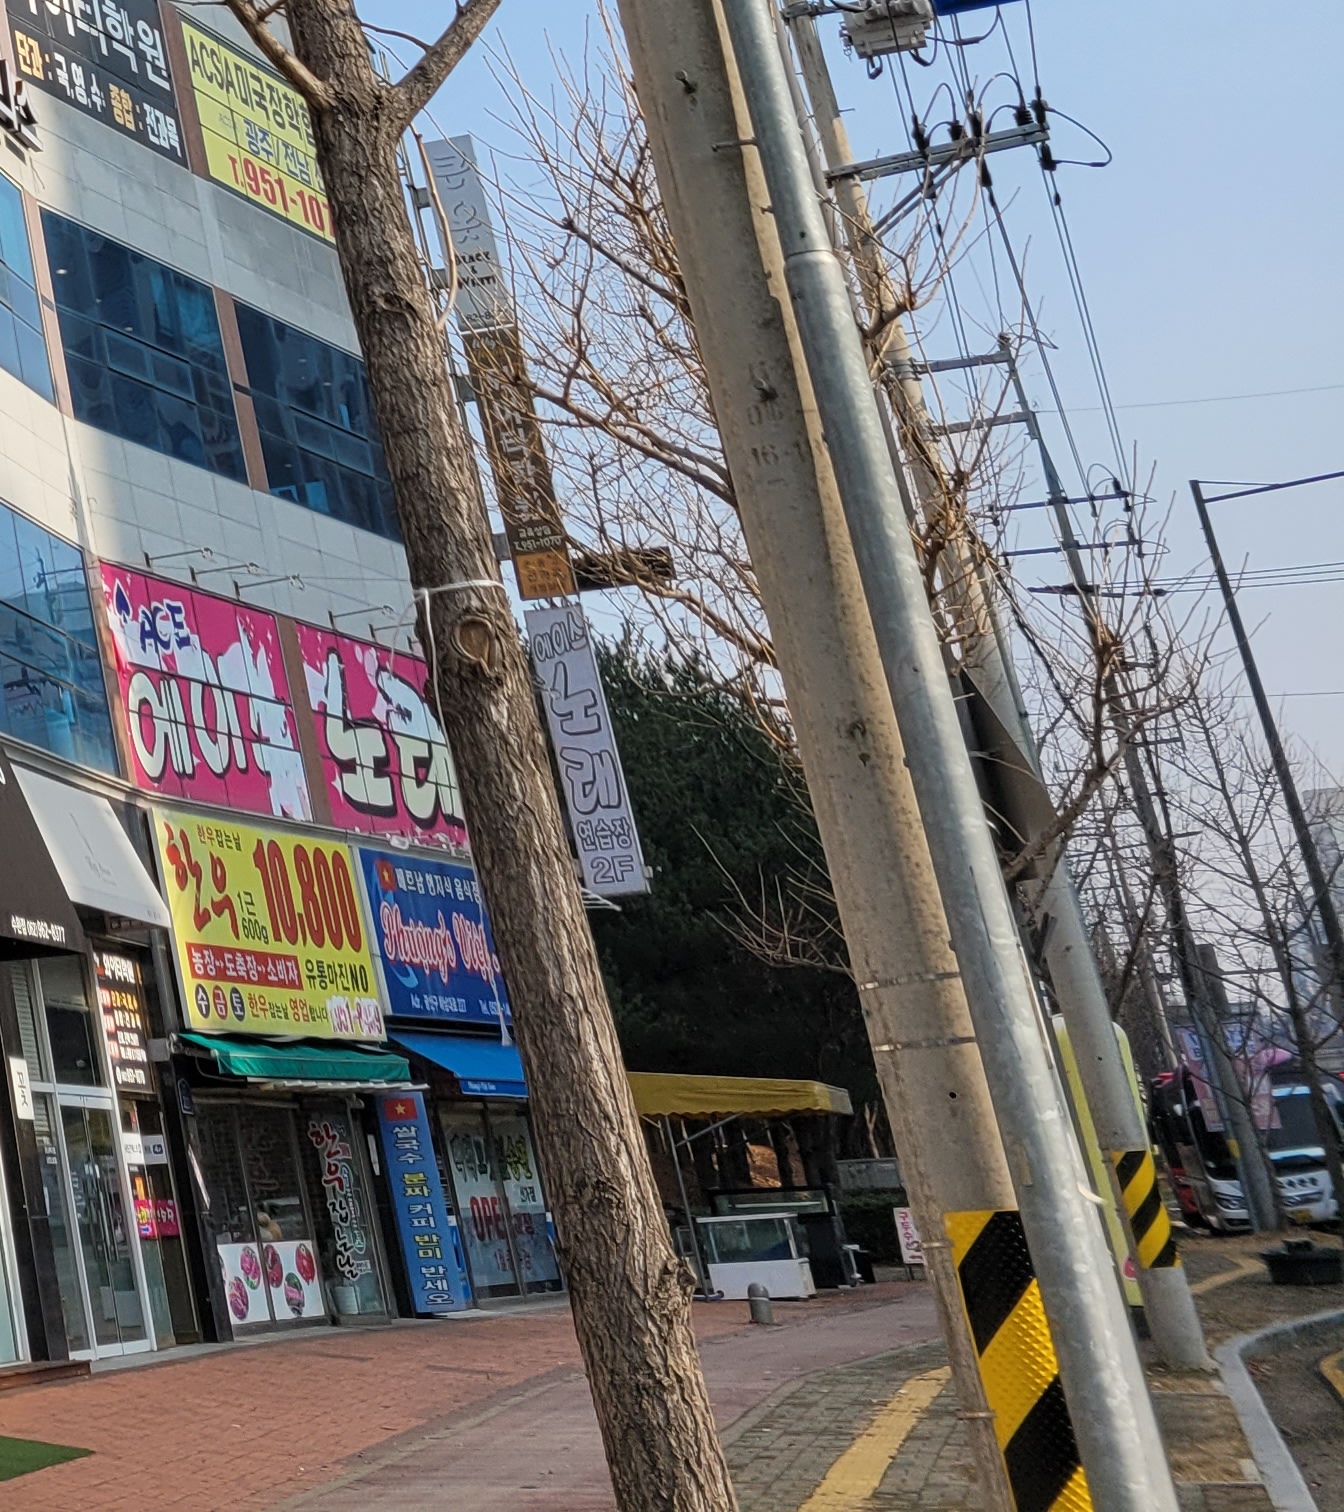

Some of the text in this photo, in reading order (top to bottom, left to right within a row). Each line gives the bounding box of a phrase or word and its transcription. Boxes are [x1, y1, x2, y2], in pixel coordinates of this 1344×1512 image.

[139, 600, 192, 653] ACE
[534, 612, 588, 663] 에이스
[550, 660, 623, 815] 노래
[577, 816, 633, 852] 연습장
[591, 855, 635, 885] 2F
[237, 890, 256, 917] 1근
[253, 838, 362, 953] 10,800
[241, 916, 270, 945] 600g
[223, 951, 259, 982] 도축장
[266, 955, 299, 986] 소비자
[196, 986, 210, 1014] 수
[213, 988, 227, 1017] 금
[230, 990, 244, 1017] 토
[391, 1125, 425, 1165] 쌀국수
[402, 1172, 432, 1198] 분짜
[408, 1203, 436, 1229] 커피
[419, 1265, 455, 1306] 반세오
